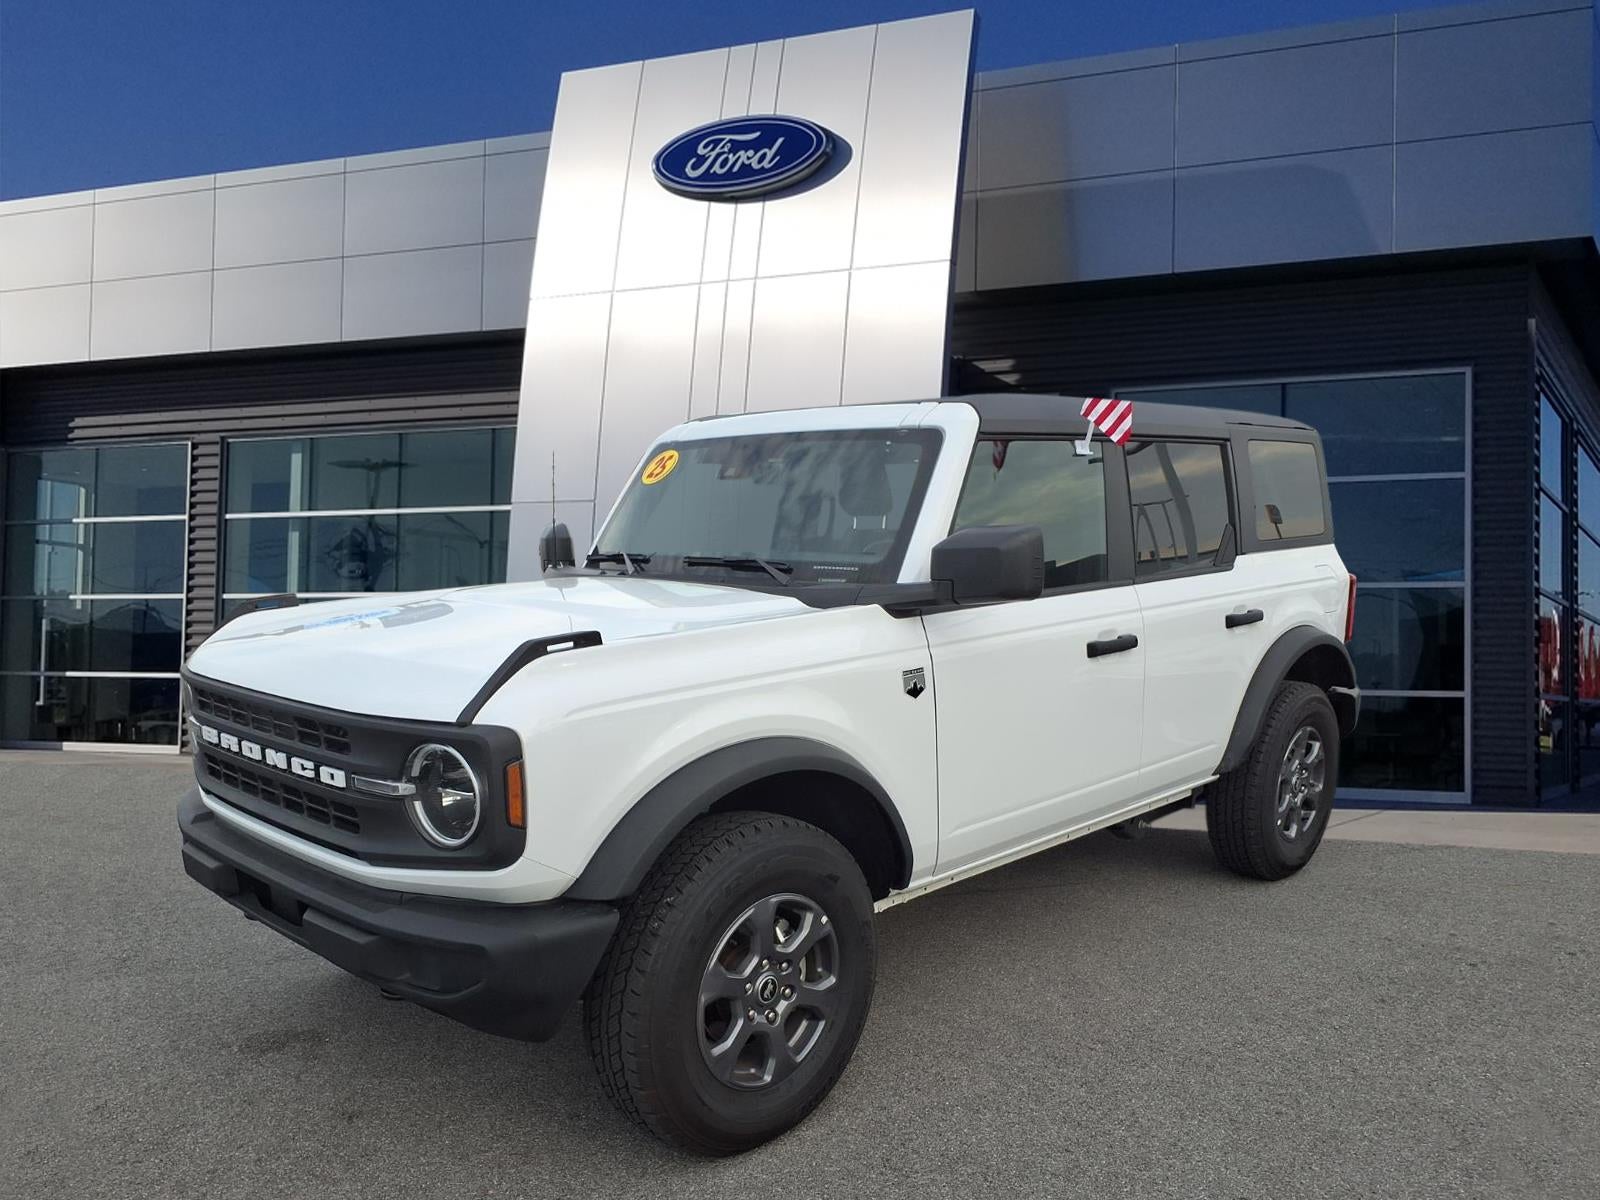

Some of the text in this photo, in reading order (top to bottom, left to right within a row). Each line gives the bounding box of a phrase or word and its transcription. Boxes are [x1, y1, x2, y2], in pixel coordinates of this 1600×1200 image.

[685, 131, 784, 178] Ford
[646, 454, 674, 479] 25
[202, 725, 346, 788] BRONCO
